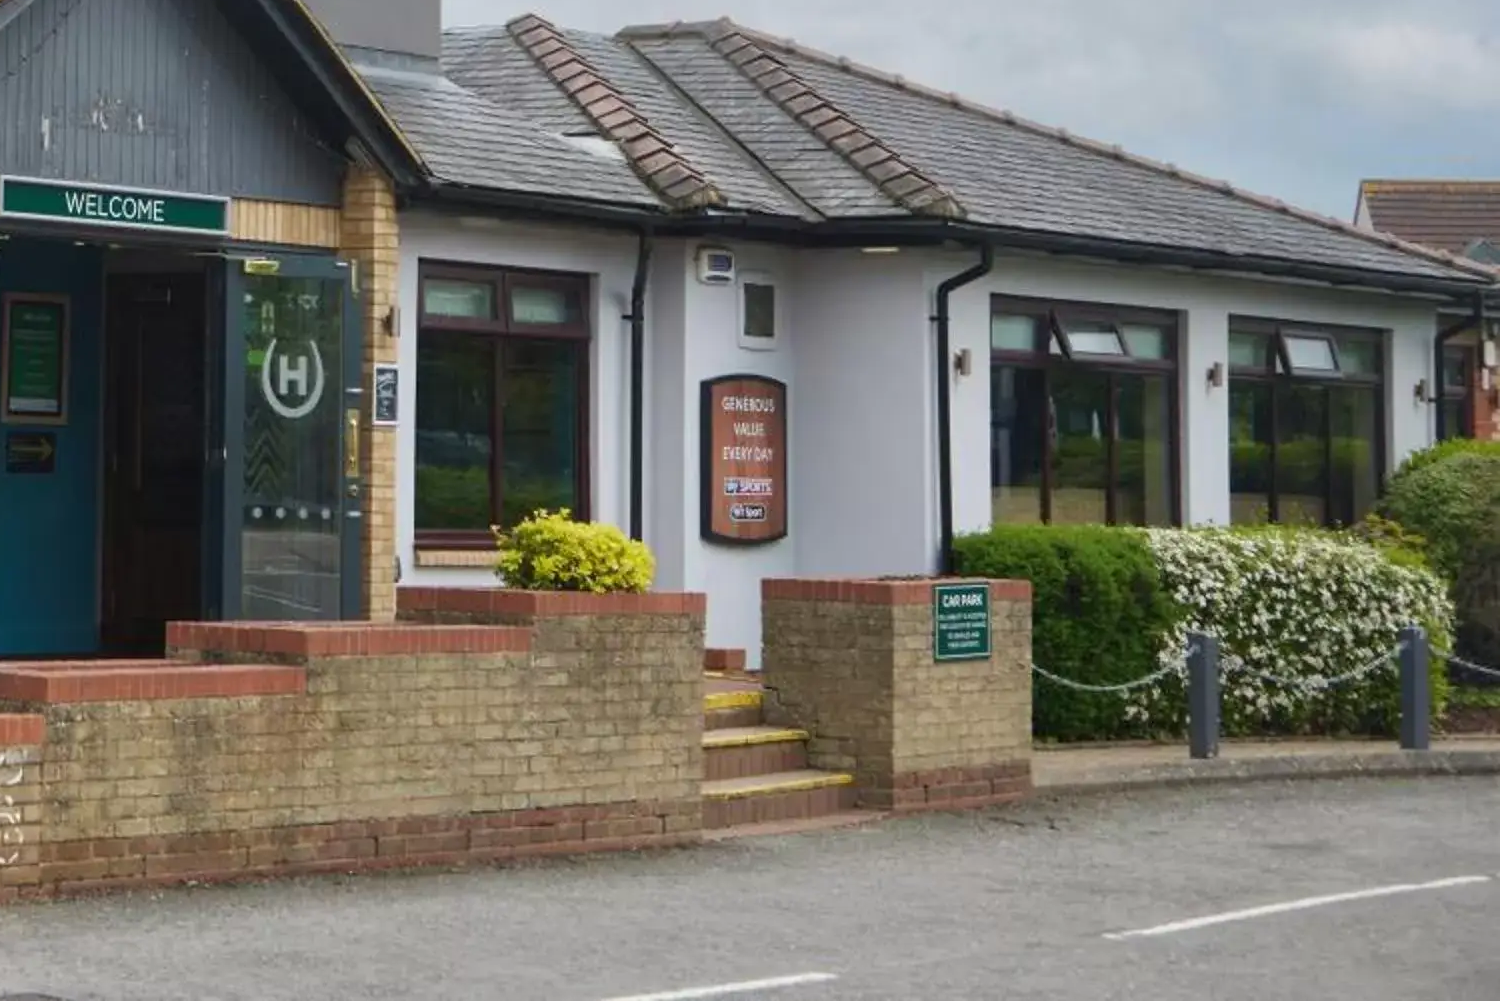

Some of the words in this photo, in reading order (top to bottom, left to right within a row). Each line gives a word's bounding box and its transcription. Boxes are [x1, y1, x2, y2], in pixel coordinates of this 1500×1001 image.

[65, 190, 165, 222] WELCOME
[279, 354, 308, 396] H
[722, 396, 775, 412] GENEROUS
[733, 422, 766, 436] VALUE
[943, 594, 961, 608] CAR
[961, 593, 983, 606] PARK
